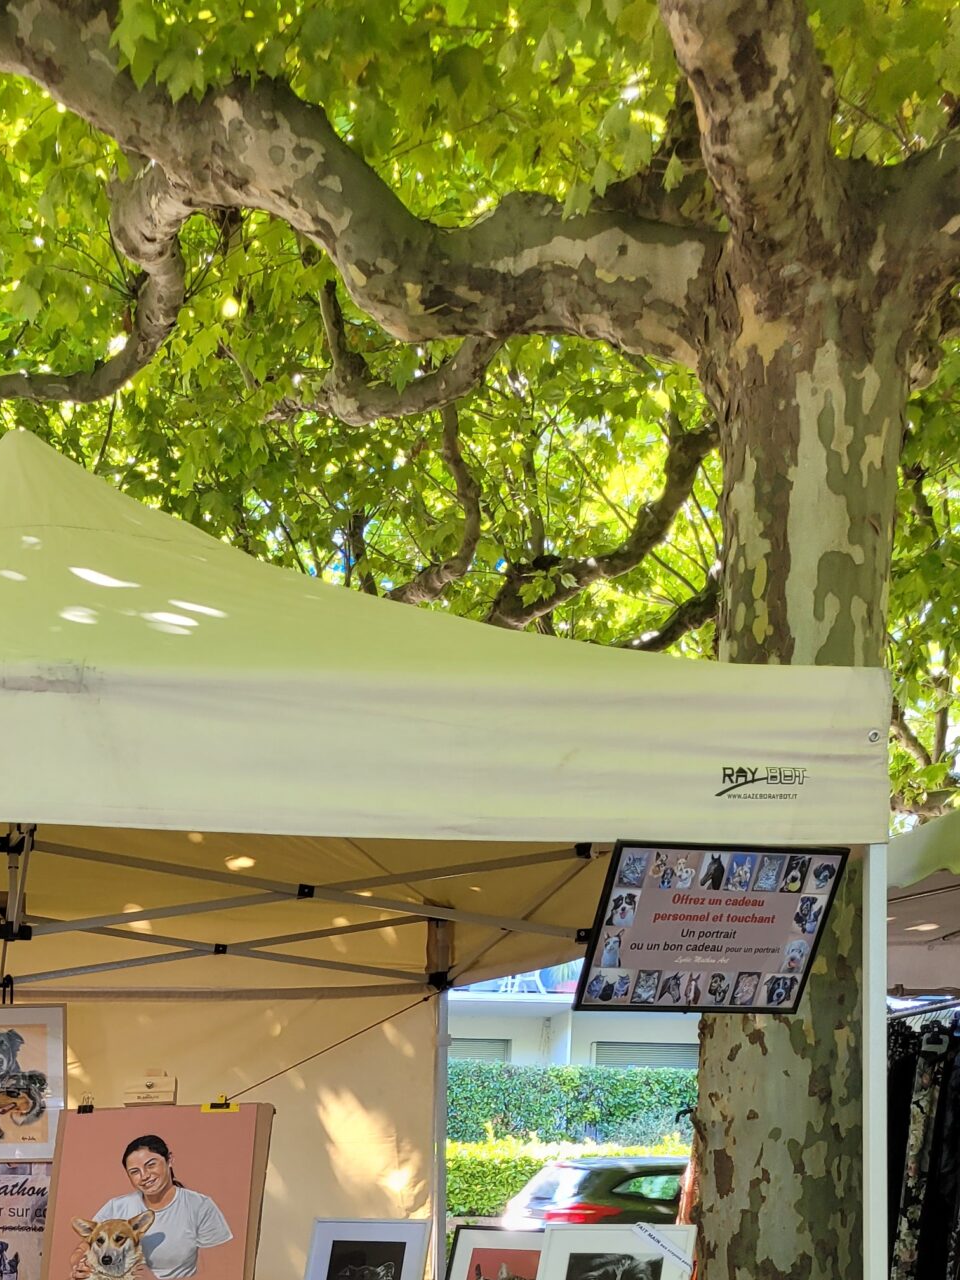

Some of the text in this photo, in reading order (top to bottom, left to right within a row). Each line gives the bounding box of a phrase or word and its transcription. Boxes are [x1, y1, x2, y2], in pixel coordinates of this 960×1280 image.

[722, 766, 758, 784] RAY
[672, 893, 765, 907] Offrez un cadeau
[653, 912, 776, 924] personnel et touchant
[681, 928, 737, 940] Un portrait
[630, 942, 644, 951] ou
[647, 943, 660, 951] un
[663, 941, 683, 952] bon
[686, 943, 723, 953] cadeau
[754, 946, 780, 955] portrait
[8, 1207, 30, 1217] sur
